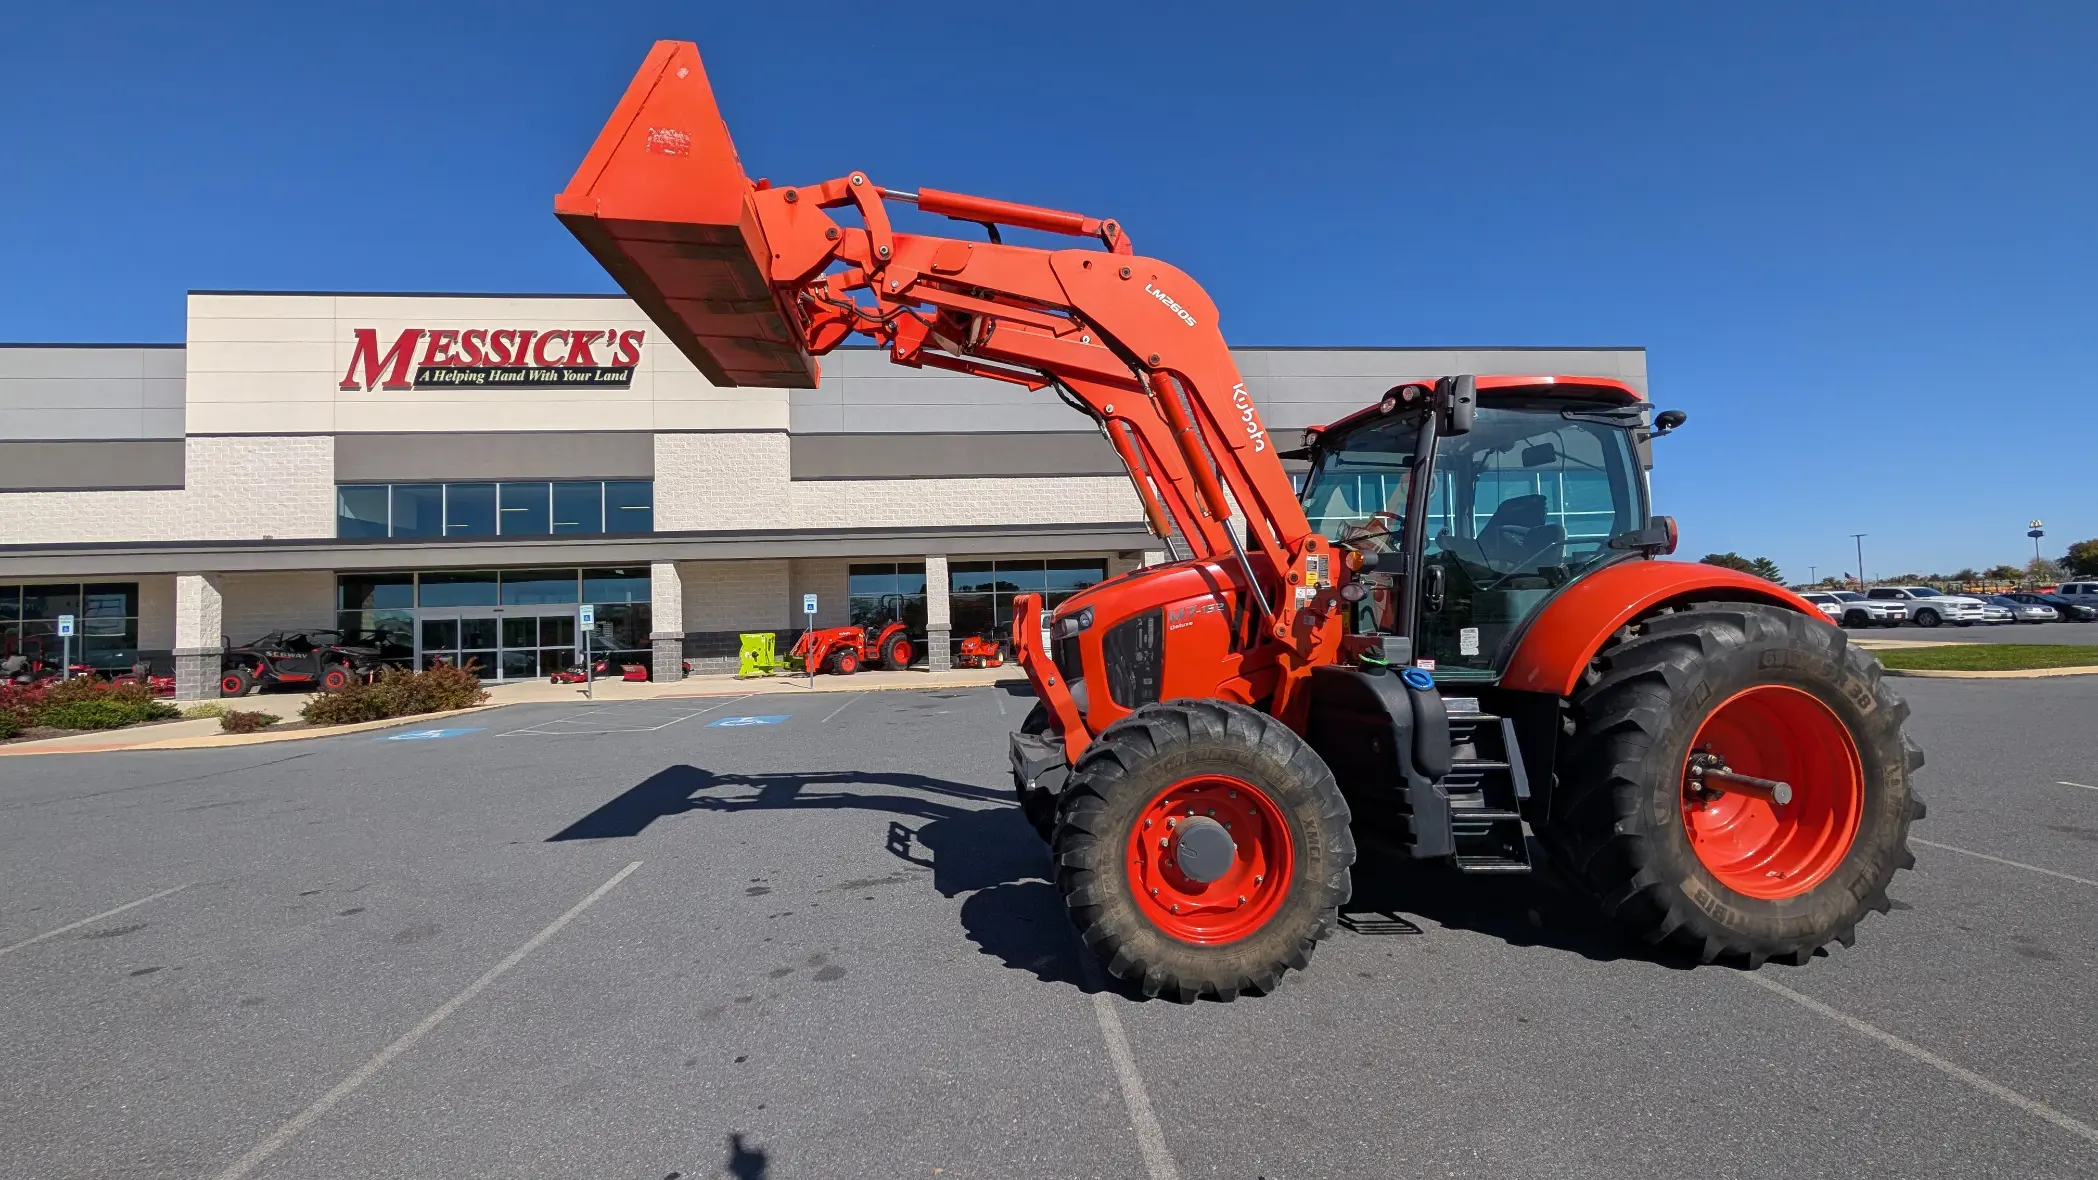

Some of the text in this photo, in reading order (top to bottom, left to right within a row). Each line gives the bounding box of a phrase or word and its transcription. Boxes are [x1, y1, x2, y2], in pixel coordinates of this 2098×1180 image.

[1144, 283, 1198, 327] LM2605
[339, 328, 645, 391] MESSICK'S
[419, 369, 629, 384] A Helping Hand With Your Land
[1232, 382, 1265, 453] Kubota
[1169, 621, 1194, 631] Deluxe
